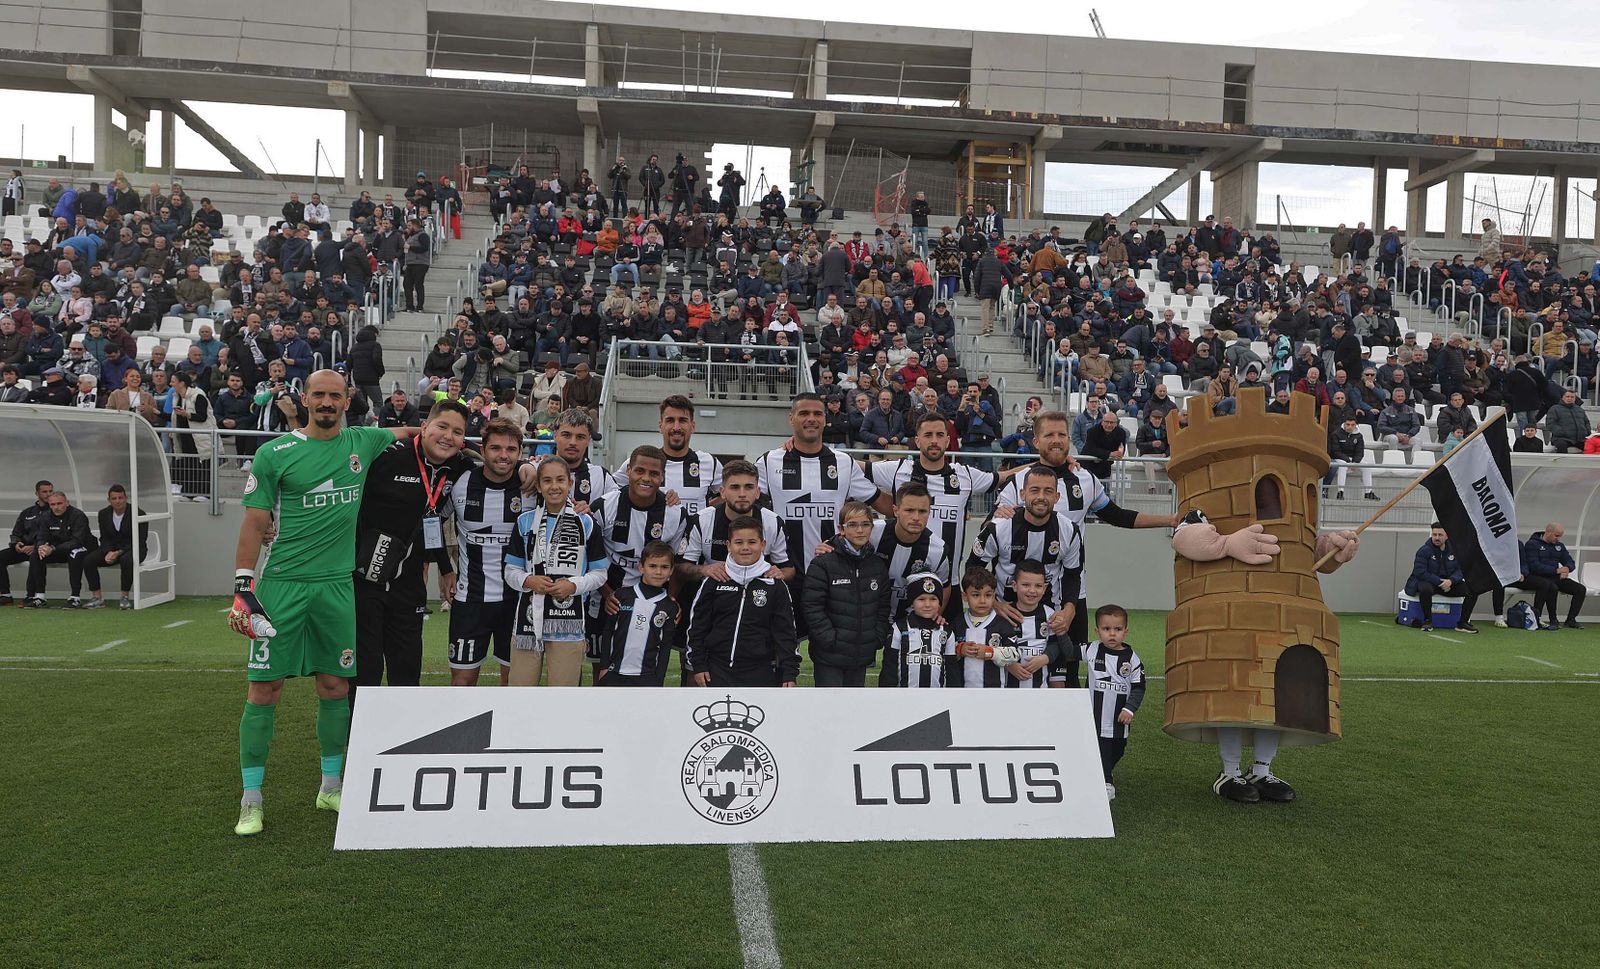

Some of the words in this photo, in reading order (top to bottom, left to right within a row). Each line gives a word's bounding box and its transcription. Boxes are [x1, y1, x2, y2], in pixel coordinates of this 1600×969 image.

[393, 474, 421, 484] LEGEA
[303, 489, 360, 508] LOTUS
[1471, 475, 1513, 539] BALONA
[785, 506, 835, 518] LOTUS
[931, 508, 958, 520] TUS
[370, 538, 391, 580] adidas
[549, 608, 576, 616] BALONA
[456, 638, 475, 662] 11
[906, 655, 943, 666] LOTUS
[685, 754, 702, 786] REAL
[700, 734, 774, 782] BALOMPEDICA
[369, 765, 603, 812] LOTUS
[853, 762, 1064, 805] LOTUS
[706, 804, 759, 822] LINENSE
